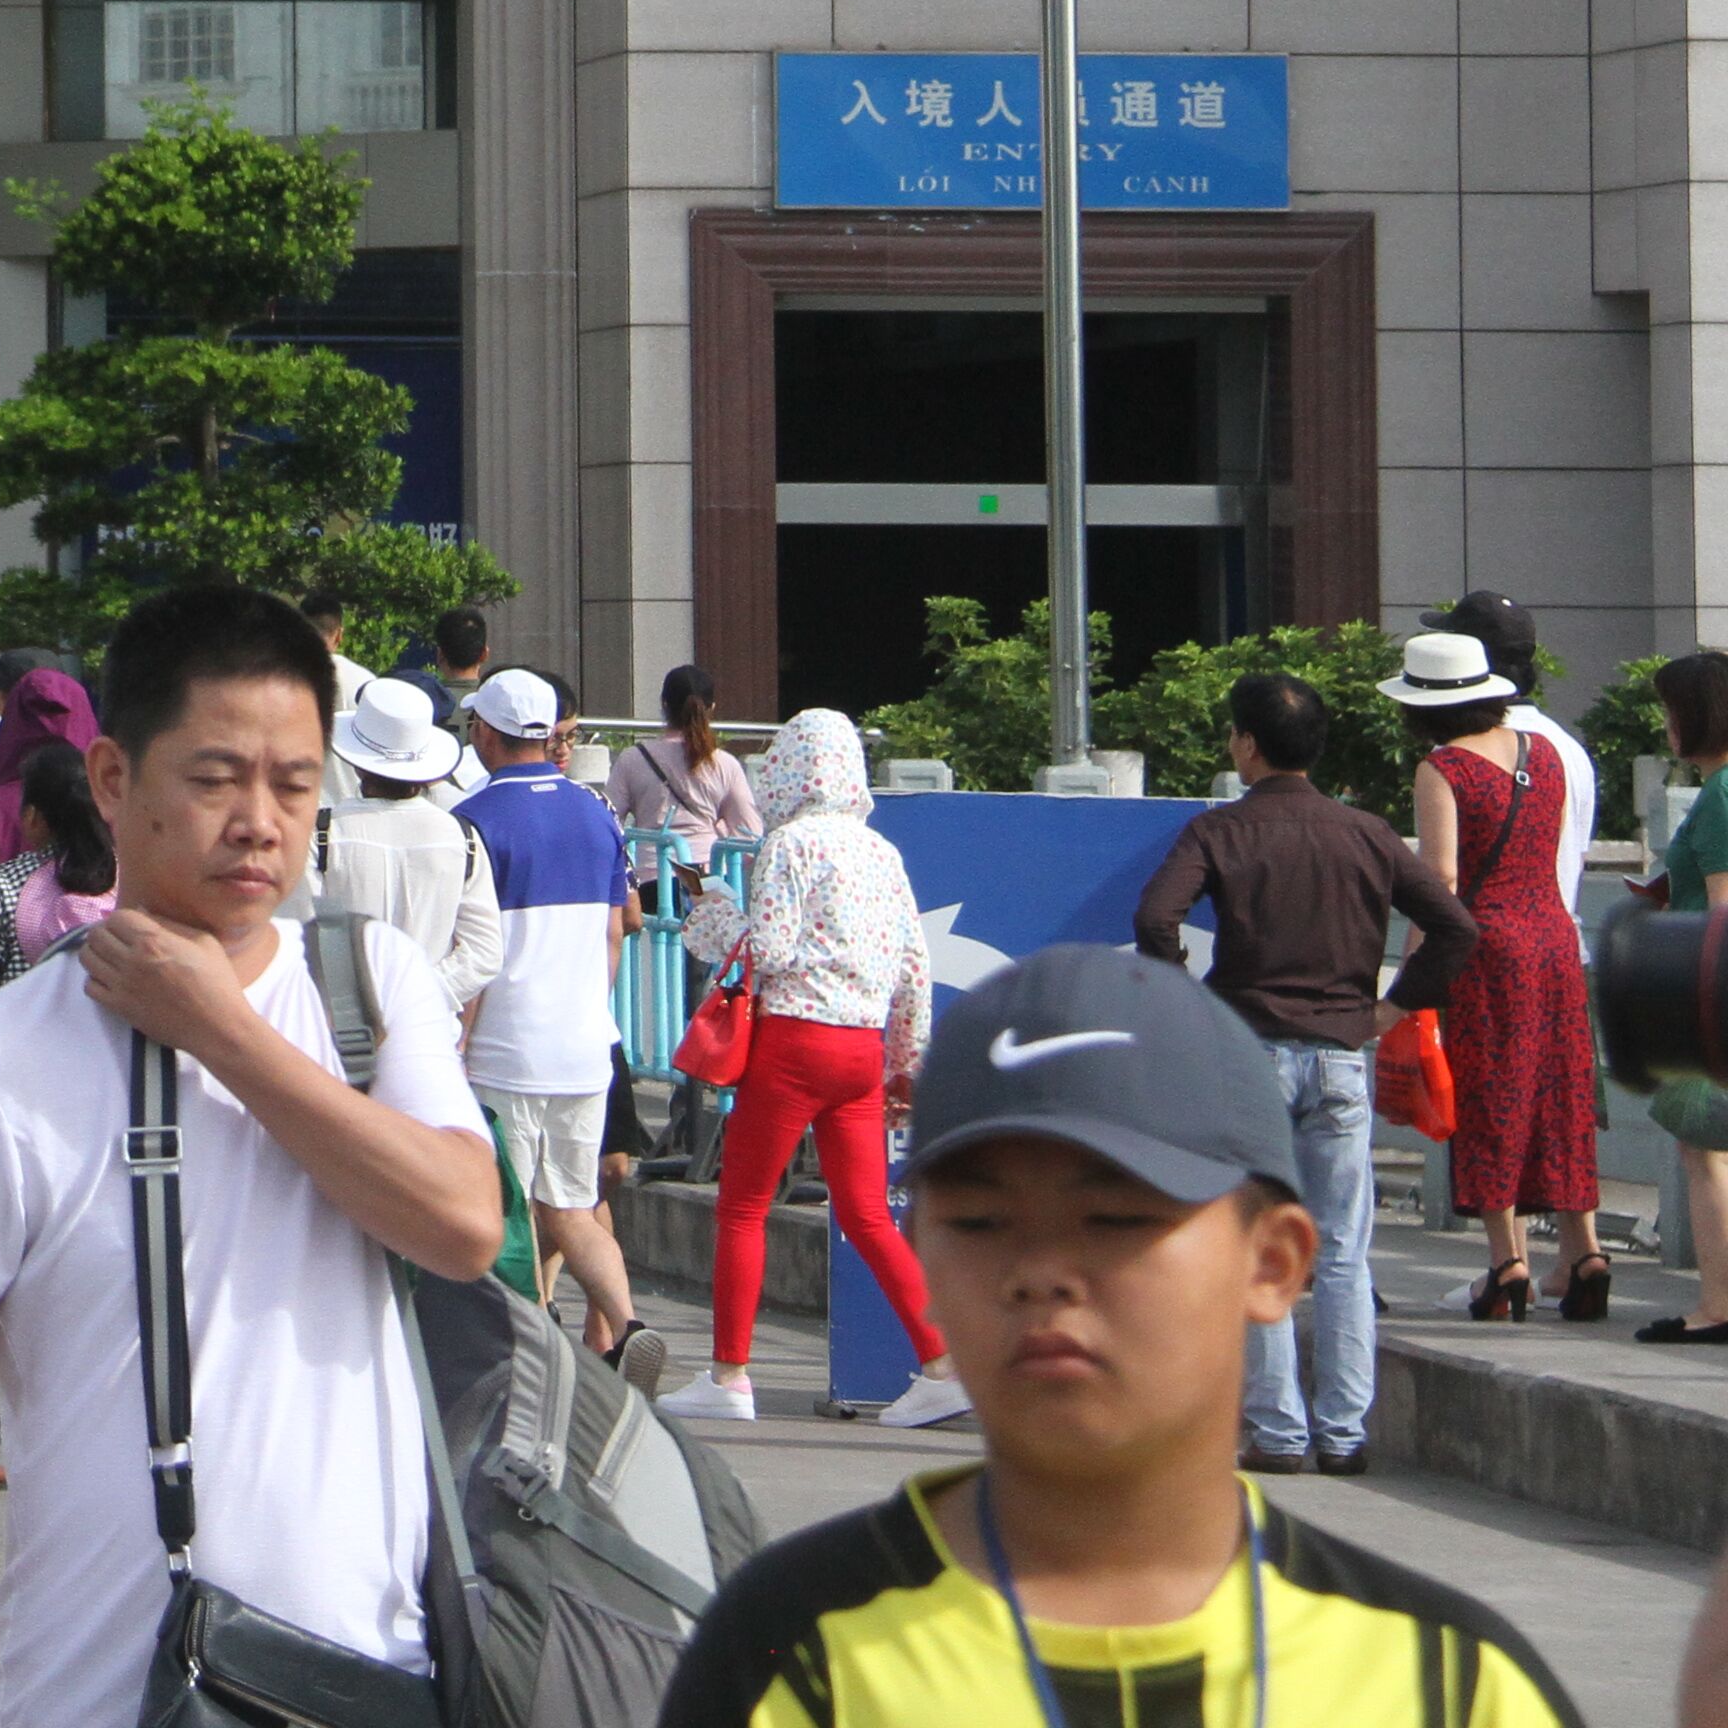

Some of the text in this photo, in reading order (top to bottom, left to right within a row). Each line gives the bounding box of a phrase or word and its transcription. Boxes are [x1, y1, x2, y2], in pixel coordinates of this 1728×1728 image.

[841, 79, 1227, 130] 入境人通道
